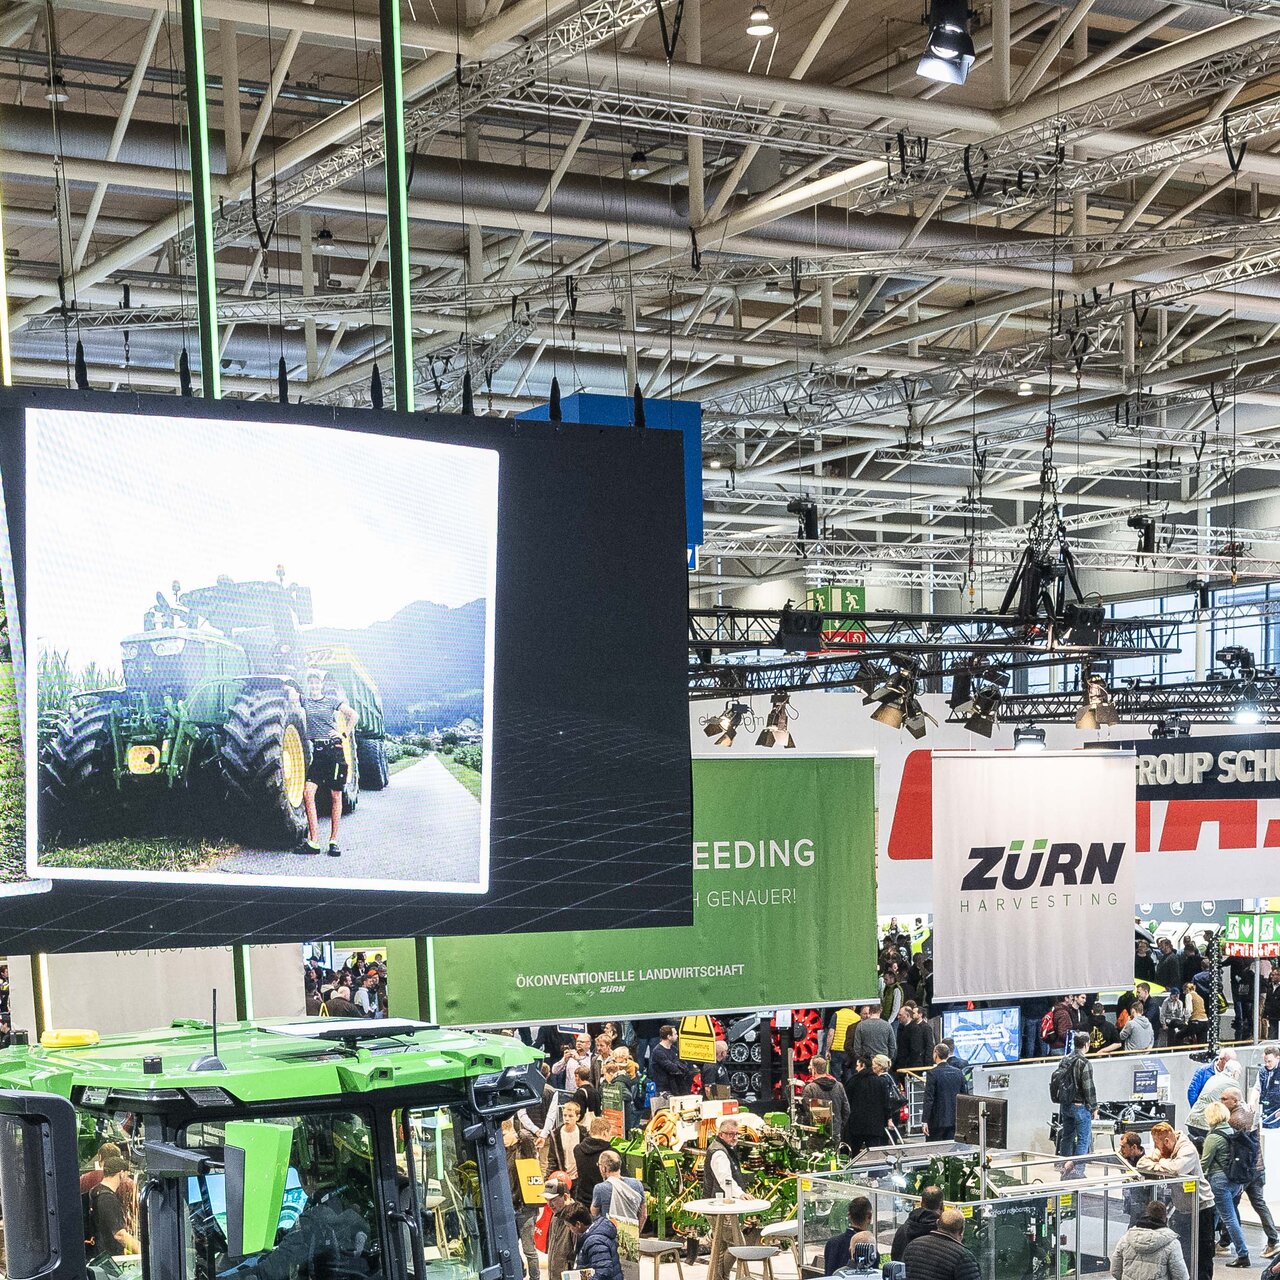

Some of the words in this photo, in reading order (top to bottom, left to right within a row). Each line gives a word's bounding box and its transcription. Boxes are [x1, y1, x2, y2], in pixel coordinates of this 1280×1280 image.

[1136, 753, 1213, 786] ROUP
[960, 839, 1127, 891] ZÜRN
[707, 888, 797, 907] GENAUER!
[960, 892, 1118, 913] HARVESTING
[516, 970, 635, 988] ÖKONVENTIONELLE
[639, 964, 745, 981] LANDWIRTSCHAFT
[600, 985, 626, 994] ZÜRN
